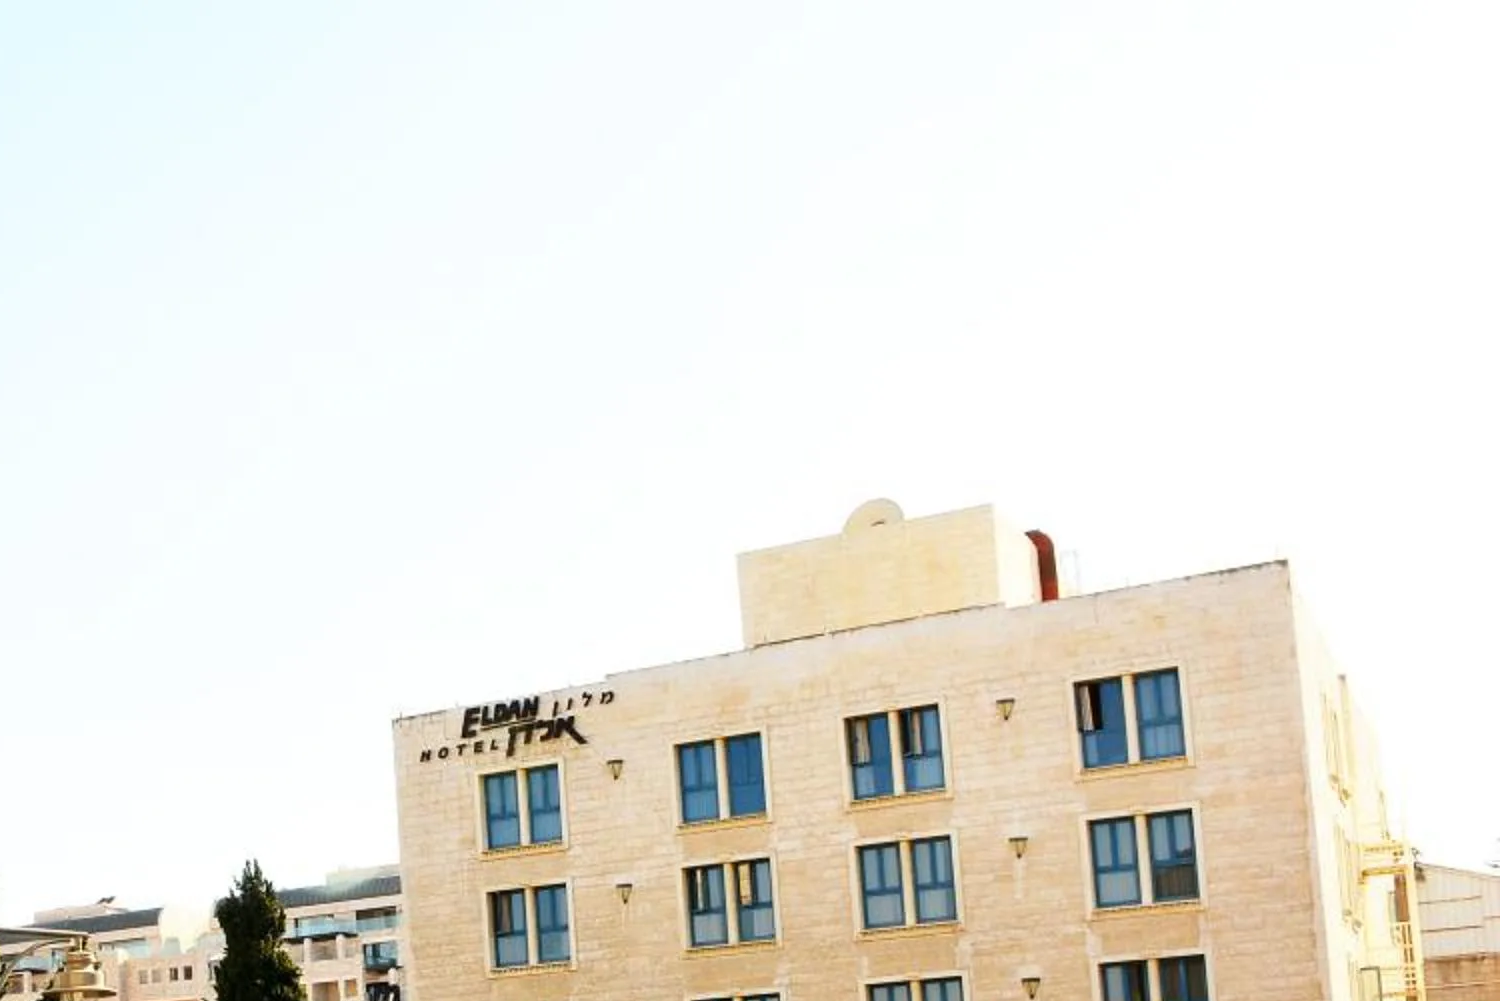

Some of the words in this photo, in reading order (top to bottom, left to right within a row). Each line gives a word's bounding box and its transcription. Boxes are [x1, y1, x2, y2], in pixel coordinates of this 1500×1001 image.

[461, 696, 540, 739] ELDAN
[552, 691, 614, 717] מלון
[420, 739, 499, 762] HOTEL
[506, 716, 588, 757] אלדן
